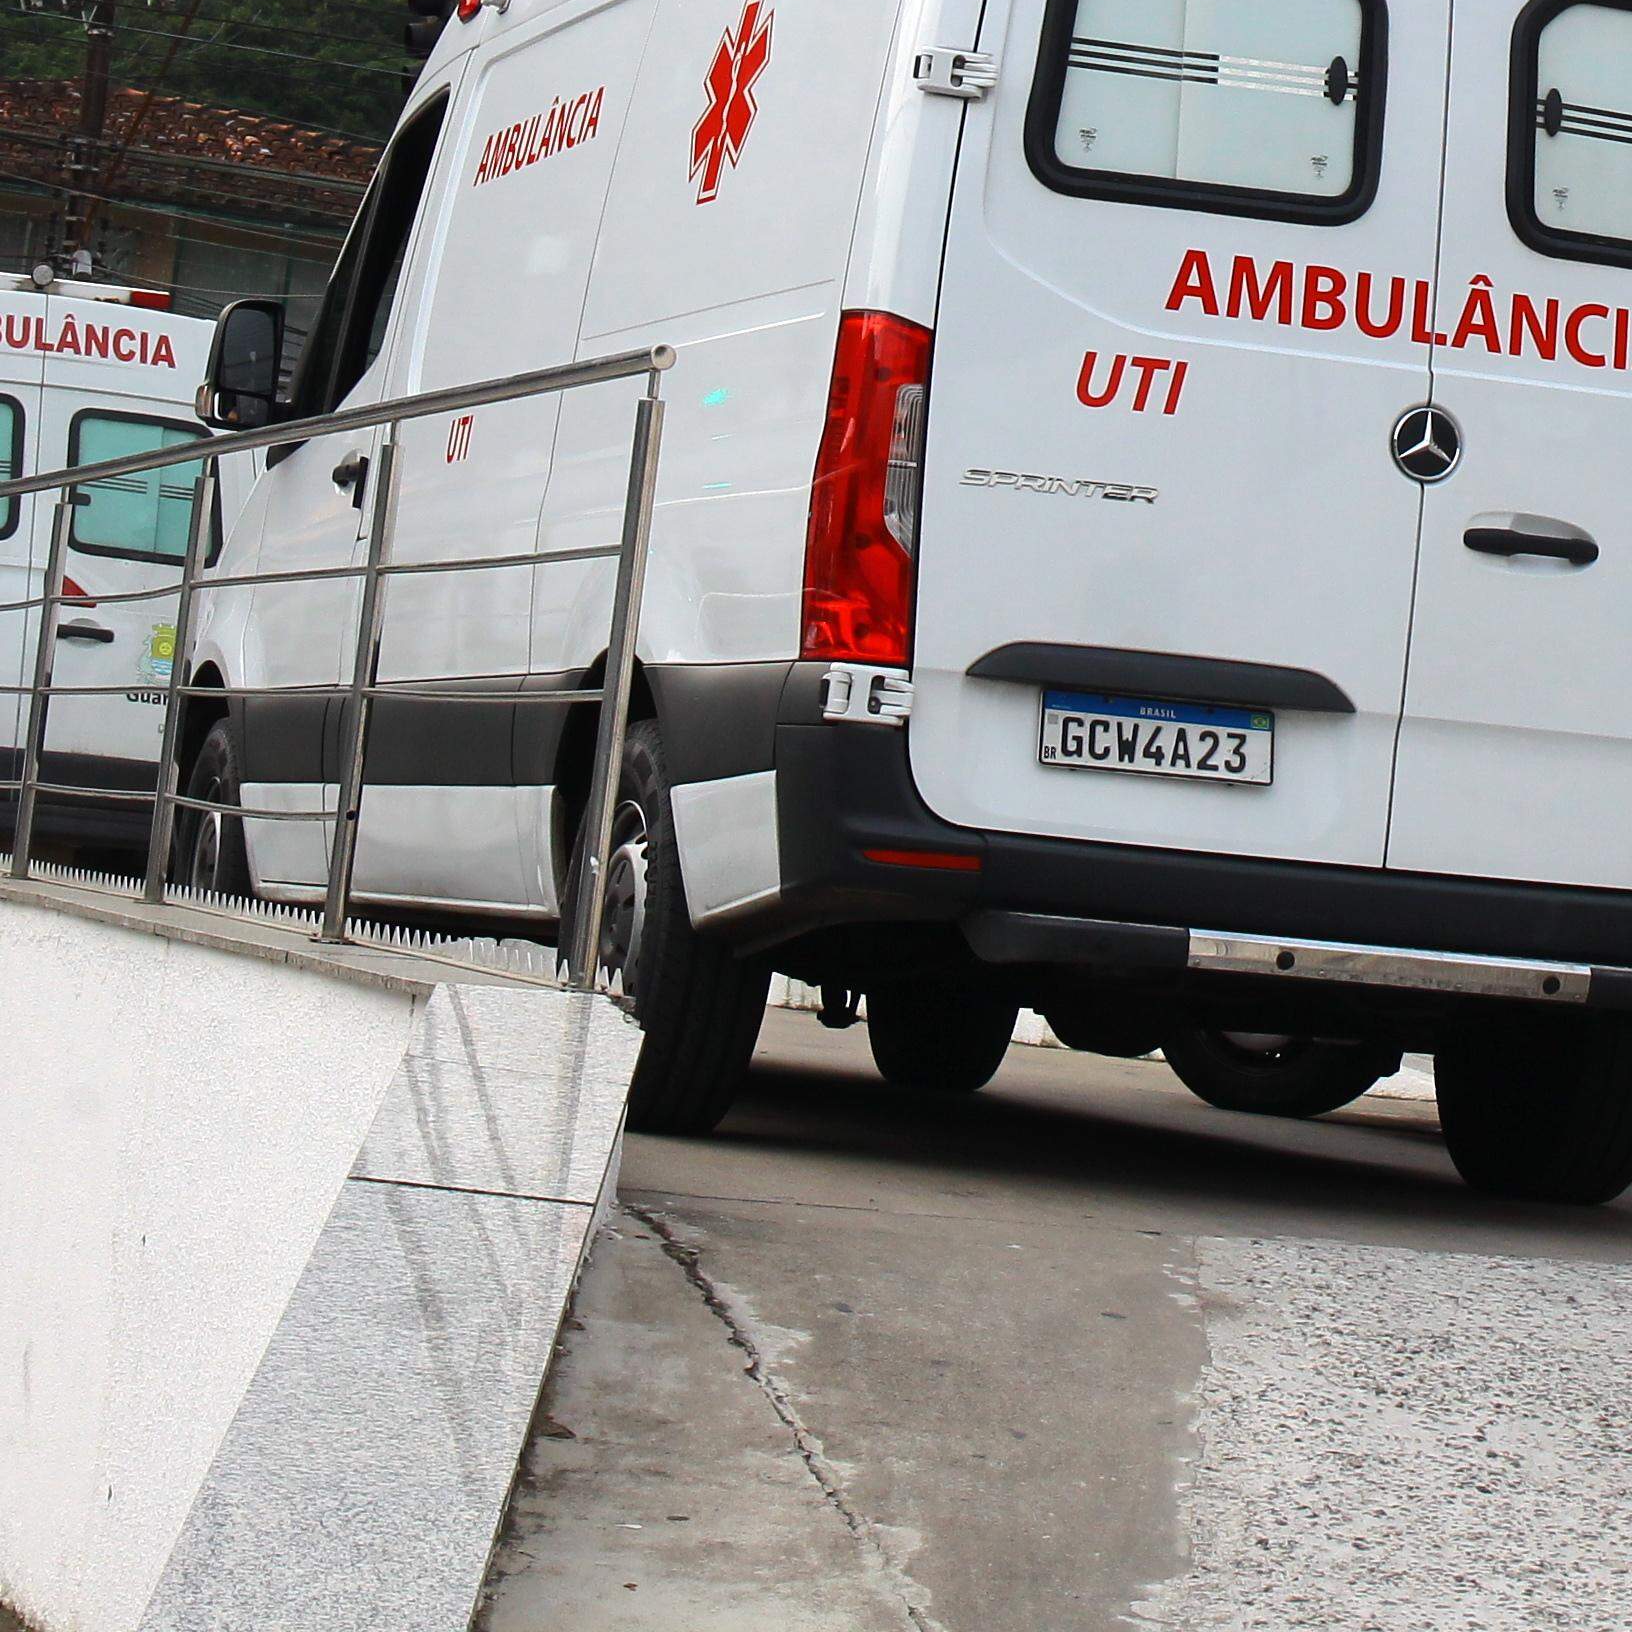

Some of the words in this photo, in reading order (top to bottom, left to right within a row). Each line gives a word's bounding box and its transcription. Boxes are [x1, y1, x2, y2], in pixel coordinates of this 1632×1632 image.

[473, 86, 607, 187] AMBULÂNCIA
[0, 314, 177, 369] ULÂNCIA
[1074, 350, 1188, 415] UTI
[446, 415, 474, 464] UTI
[959, 468, 1160, 504] SPRINTER
[1140, 707, 1176, 718] BRASIL
[1044, 746, 1057, 760] BR
[1061, 716, 1246, 773] GCW4A23
